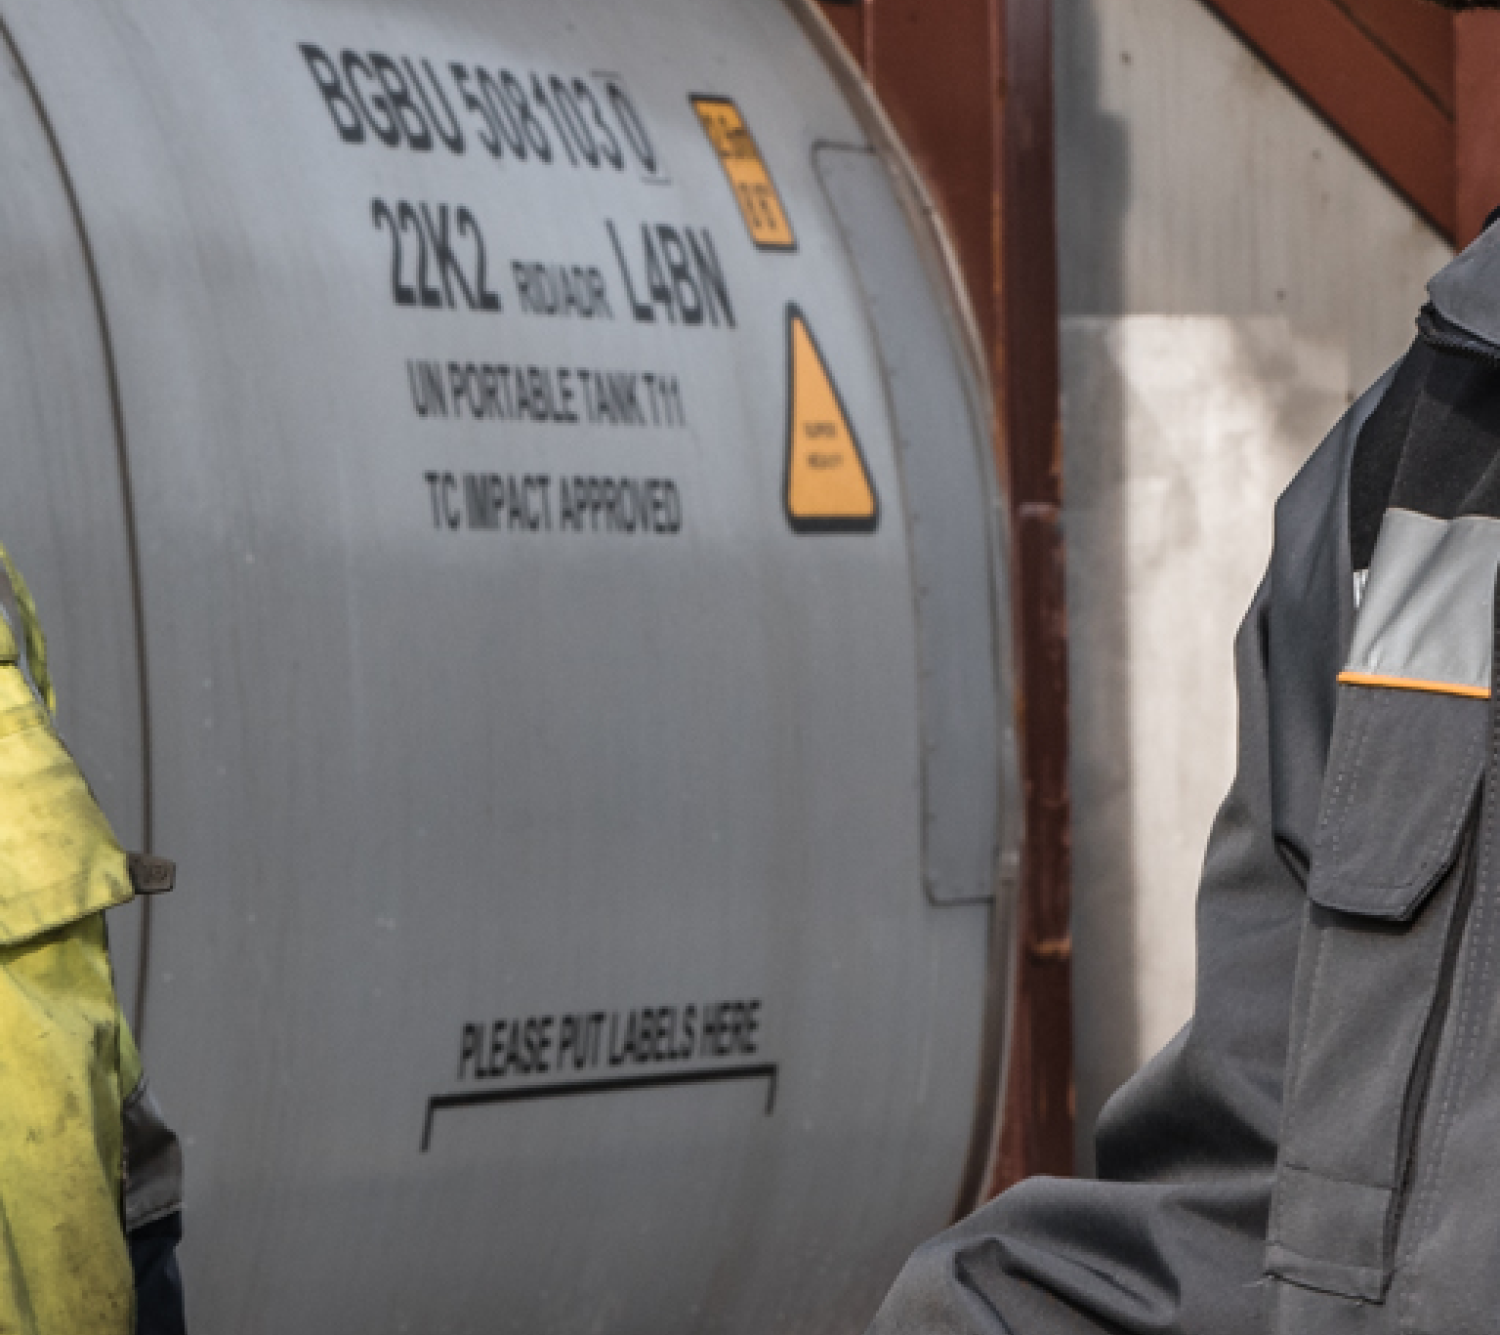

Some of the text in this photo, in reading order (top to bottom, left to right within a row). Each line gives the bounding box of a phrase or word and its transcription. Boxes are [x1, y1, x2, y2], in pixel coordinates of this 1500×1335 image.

[298, 40, 464, 156] BGBU
[370, 196, 502, 313] 22K2
[604, 217, 737, 329] L4BN
[405, 358, 688, 428] UN PORTABLE TANK T11
[422, 469, 683, 534] TC IMPACT APPROVED
[456, 997, 763, 1081] PLEASE PUT LABELS HERE
